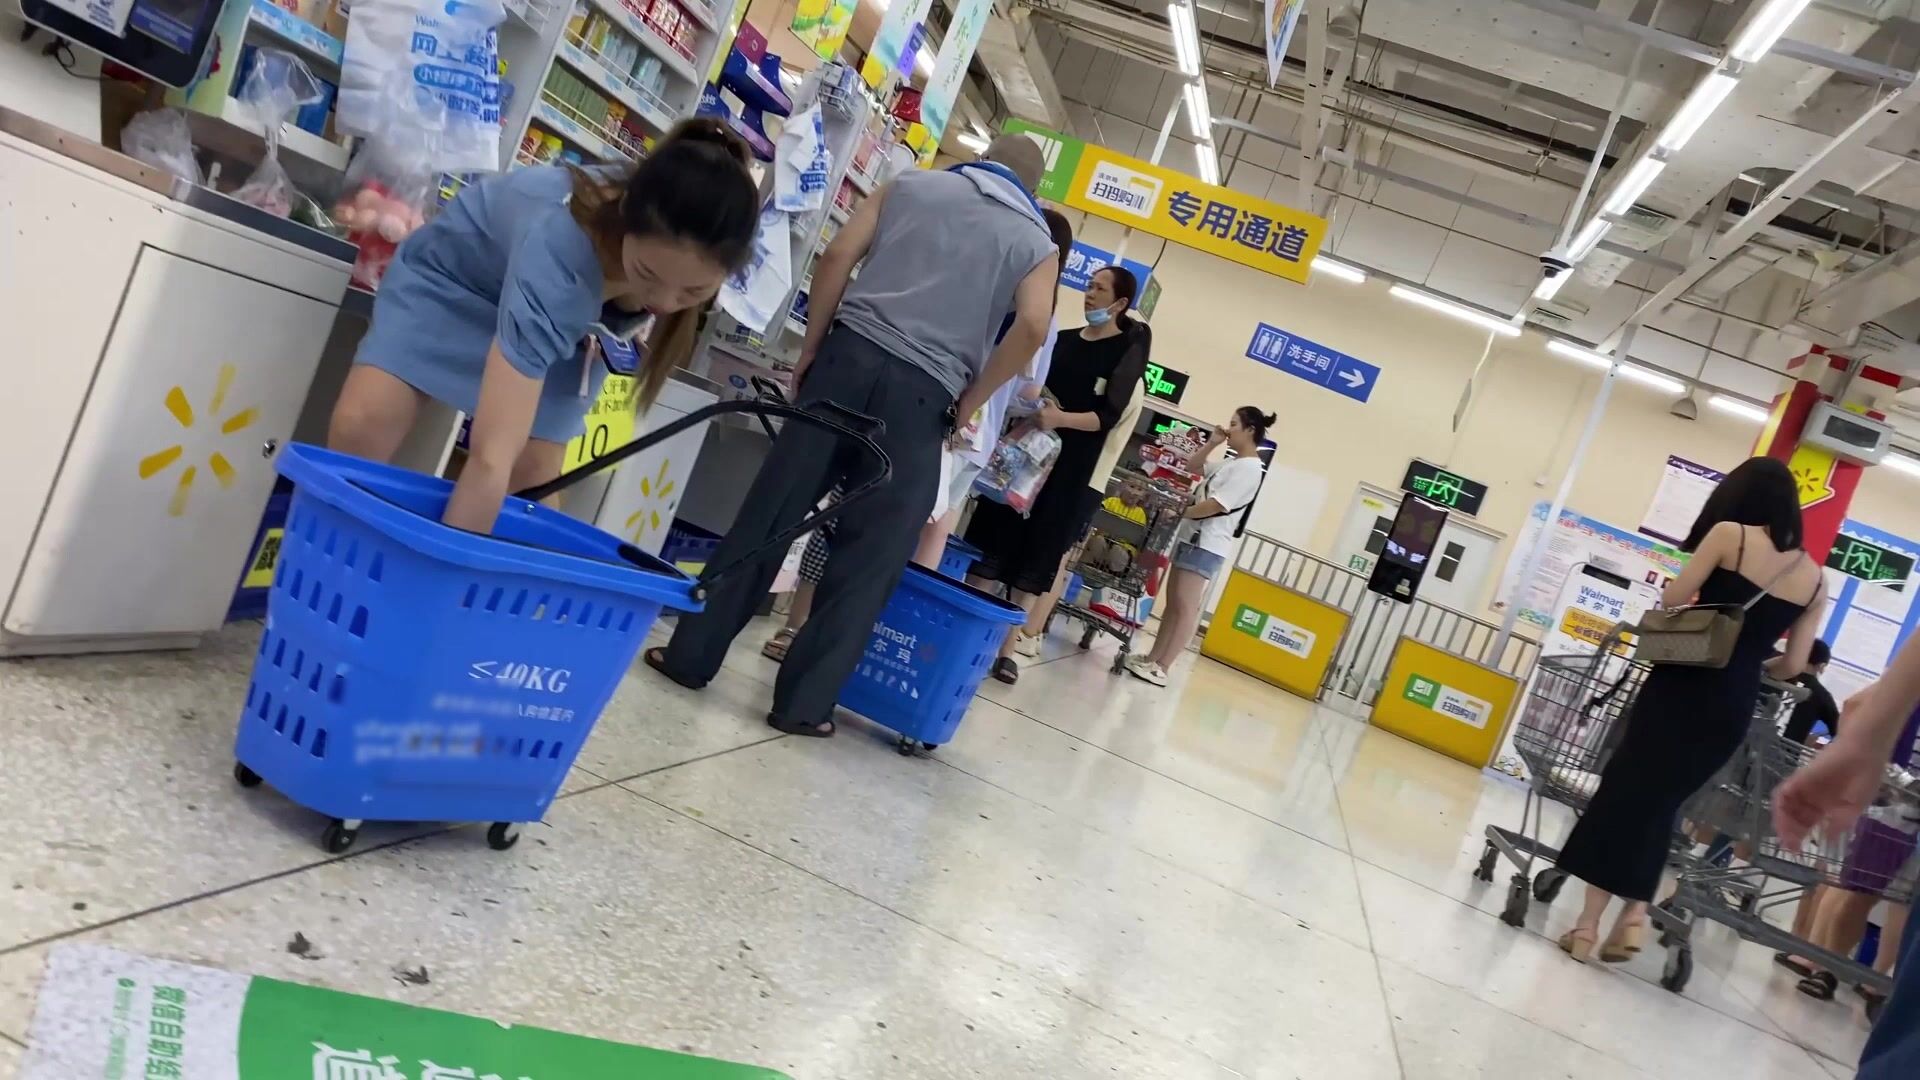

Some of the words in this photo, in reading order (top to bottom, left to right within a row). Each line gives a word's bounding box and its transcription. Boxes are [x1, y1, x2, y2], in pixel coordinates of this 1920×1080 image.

[1168, 191, 1309, 263] 专用通道
[1066, 248, 1107, 278] 物通
[1061, 271, 1085, 285] rchase
[1287, 343, 1331, 371] 洗手间
[1157, 380, 1176, 395] EXIT
[1576, 595, 1621, 619] 沃尔玛
[1581, 585, 1625, 609] Walmart
[872, 621, 917, 649] almart
[873, 638, 912, 664] 尔玛
[146, 984, 188, 1080] 微信自助结
